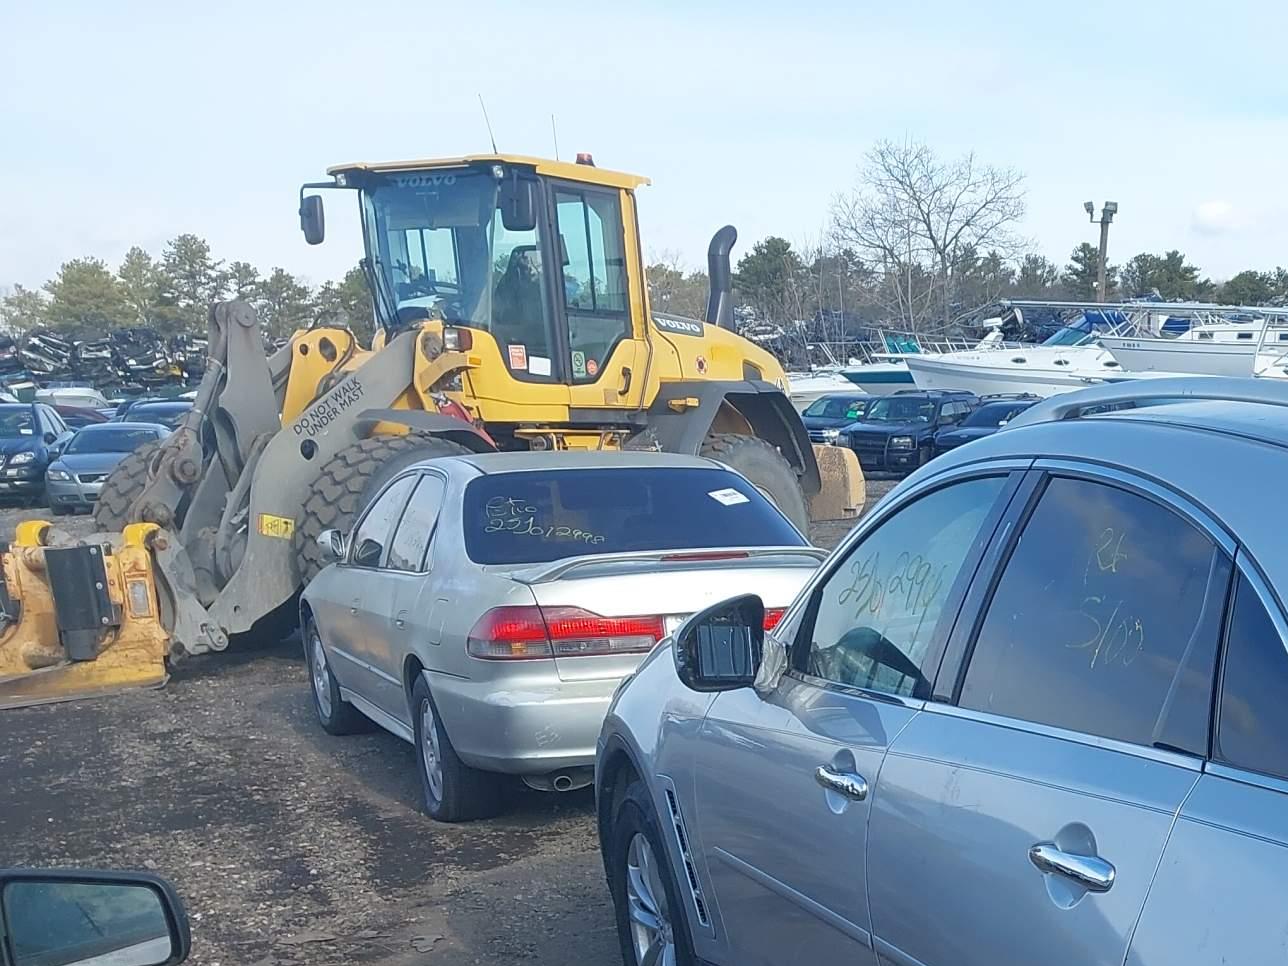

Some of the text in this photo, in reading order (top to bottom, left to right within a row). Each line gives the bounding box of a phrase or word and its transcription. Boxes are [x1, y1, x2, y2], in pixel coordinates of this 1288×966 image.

[398, 175, 456, 188] VOLVO
[653, 317, 701, 332] VOLVO
[293, 376, 361, 436] DO NOT WALK
[306, 385, 364, 437] UNDER MAST
